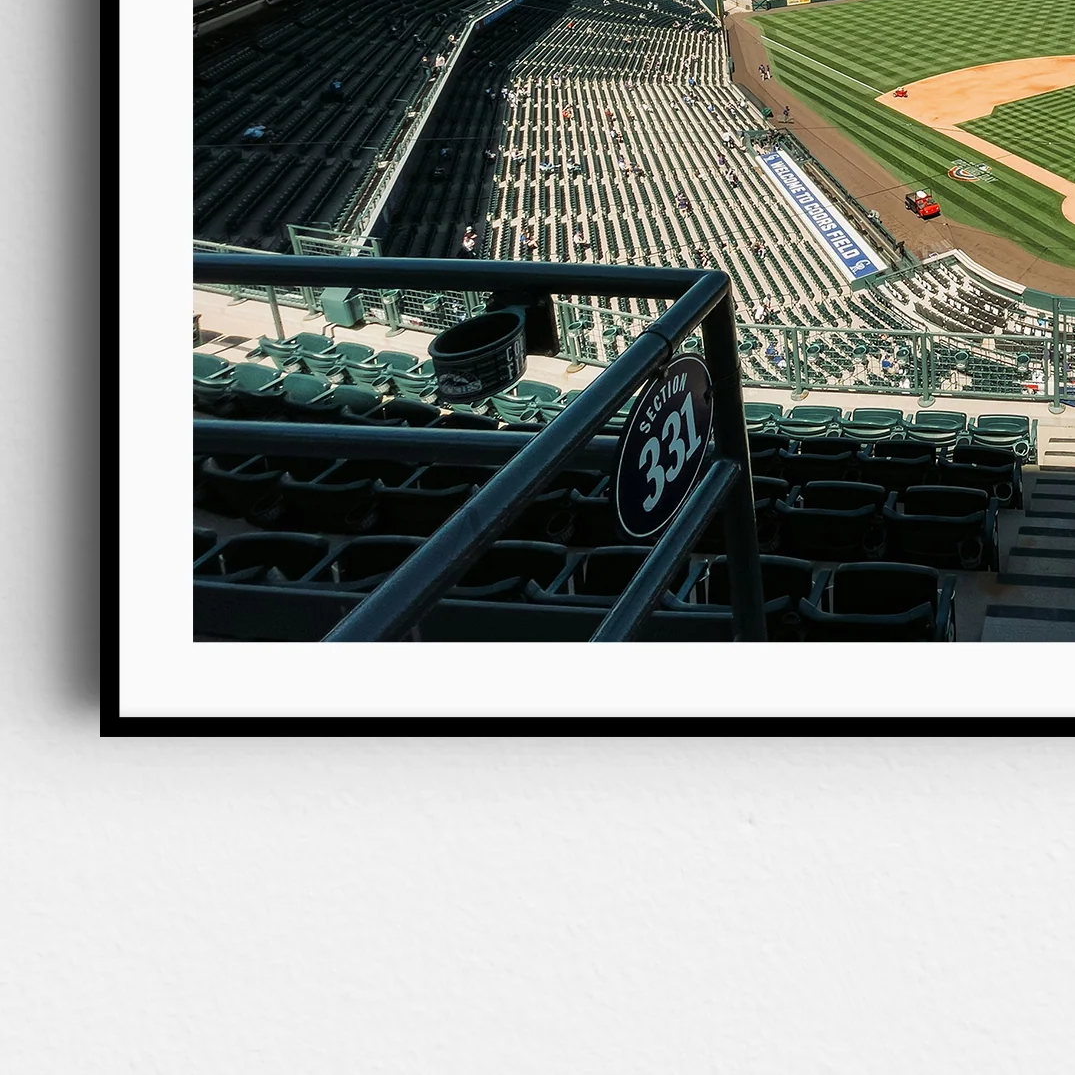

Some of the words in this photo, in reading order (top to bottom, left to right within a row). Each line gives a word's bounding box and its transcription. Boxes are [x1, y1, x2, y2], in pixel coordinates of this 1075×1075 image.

[770, 161, 806, 195] WELCOME
[796, 191, 815, 206] TO
[804, 203, 838, 233] COORS
[826, 231, 861, 260] FIELD
[639, 372, 688, 434] SECTION
[638, 391, 702, 513] 331
